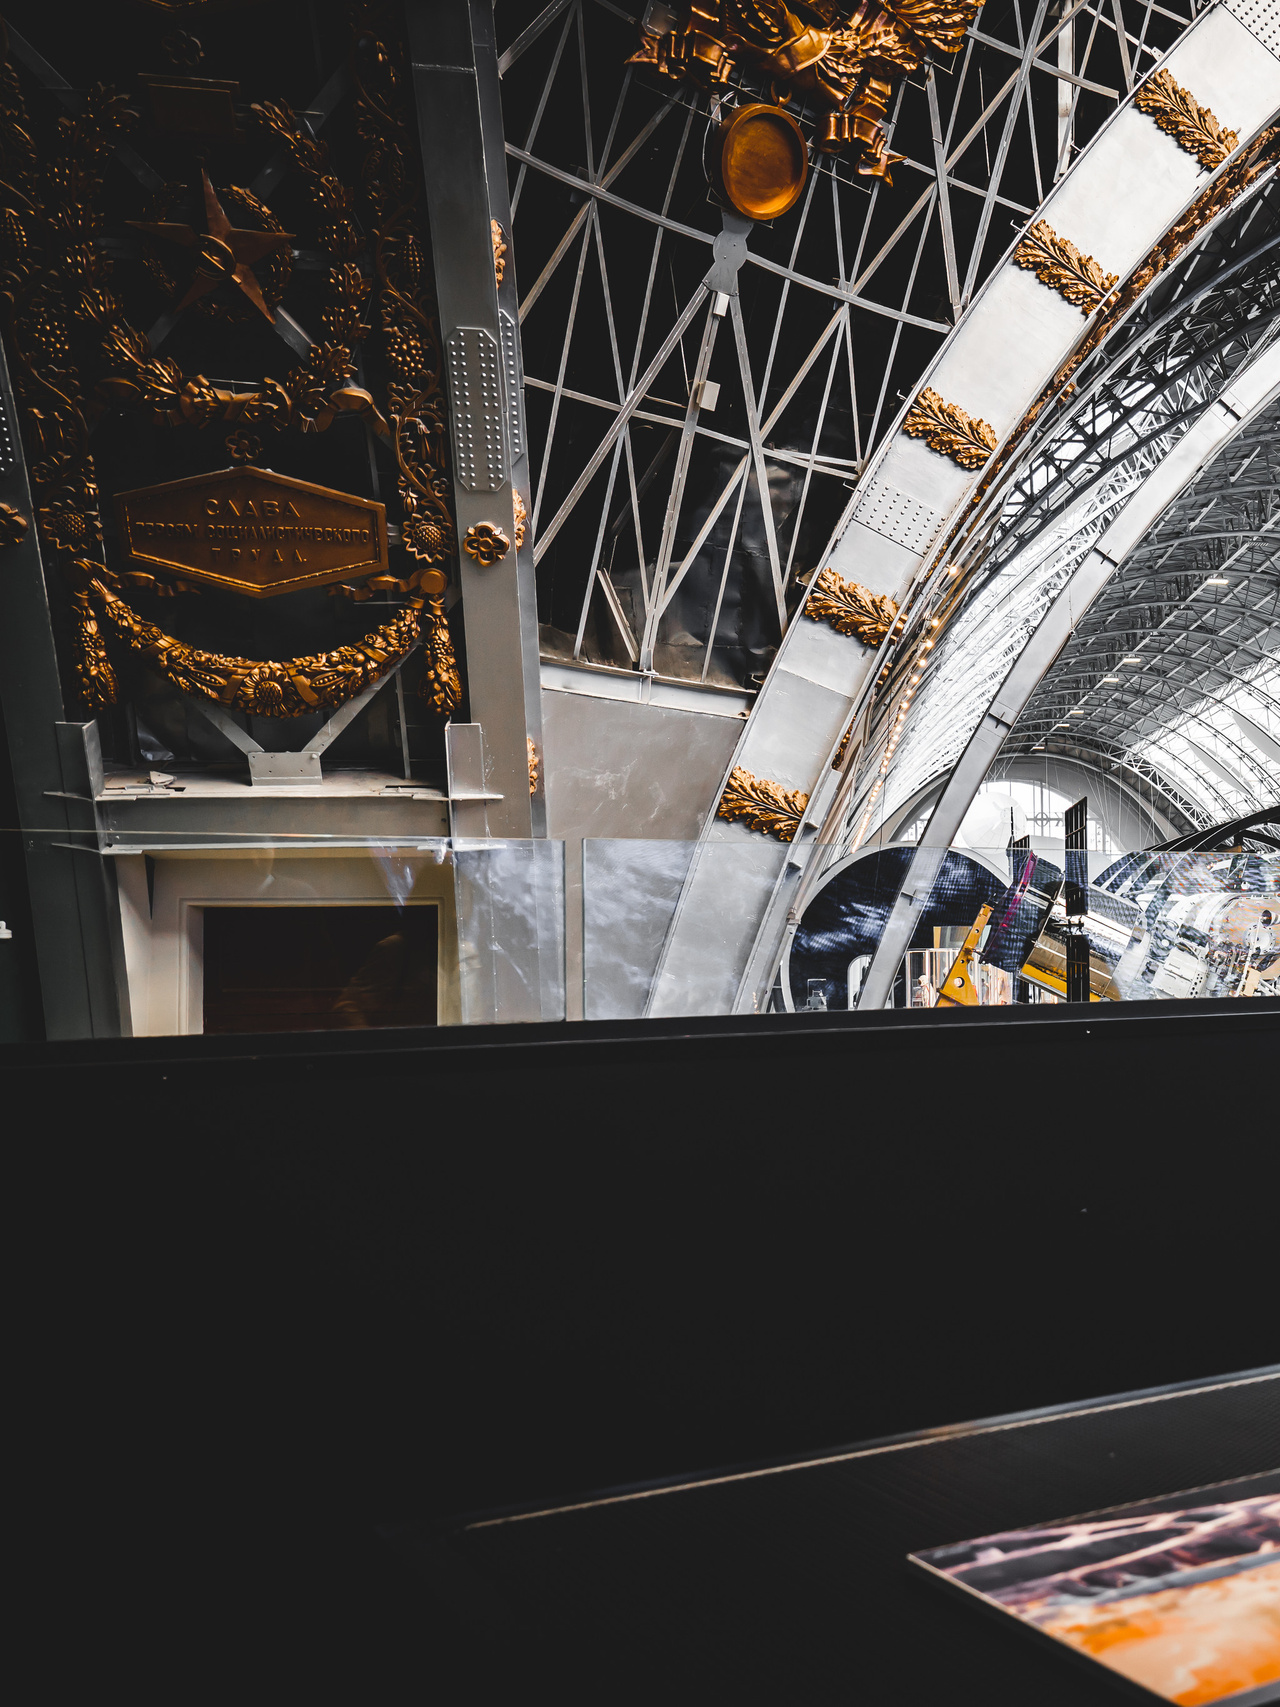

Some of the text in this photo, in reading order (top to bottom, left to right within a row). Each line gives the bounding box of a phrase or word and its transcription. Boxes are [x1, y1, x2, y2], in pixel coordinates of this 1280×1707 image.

[206, 498, 301, 518] СЛАВА
[135, 521, 370, 543] ГЕРОЯМ СОЦИАЛИСТИЧЕСКОГО
